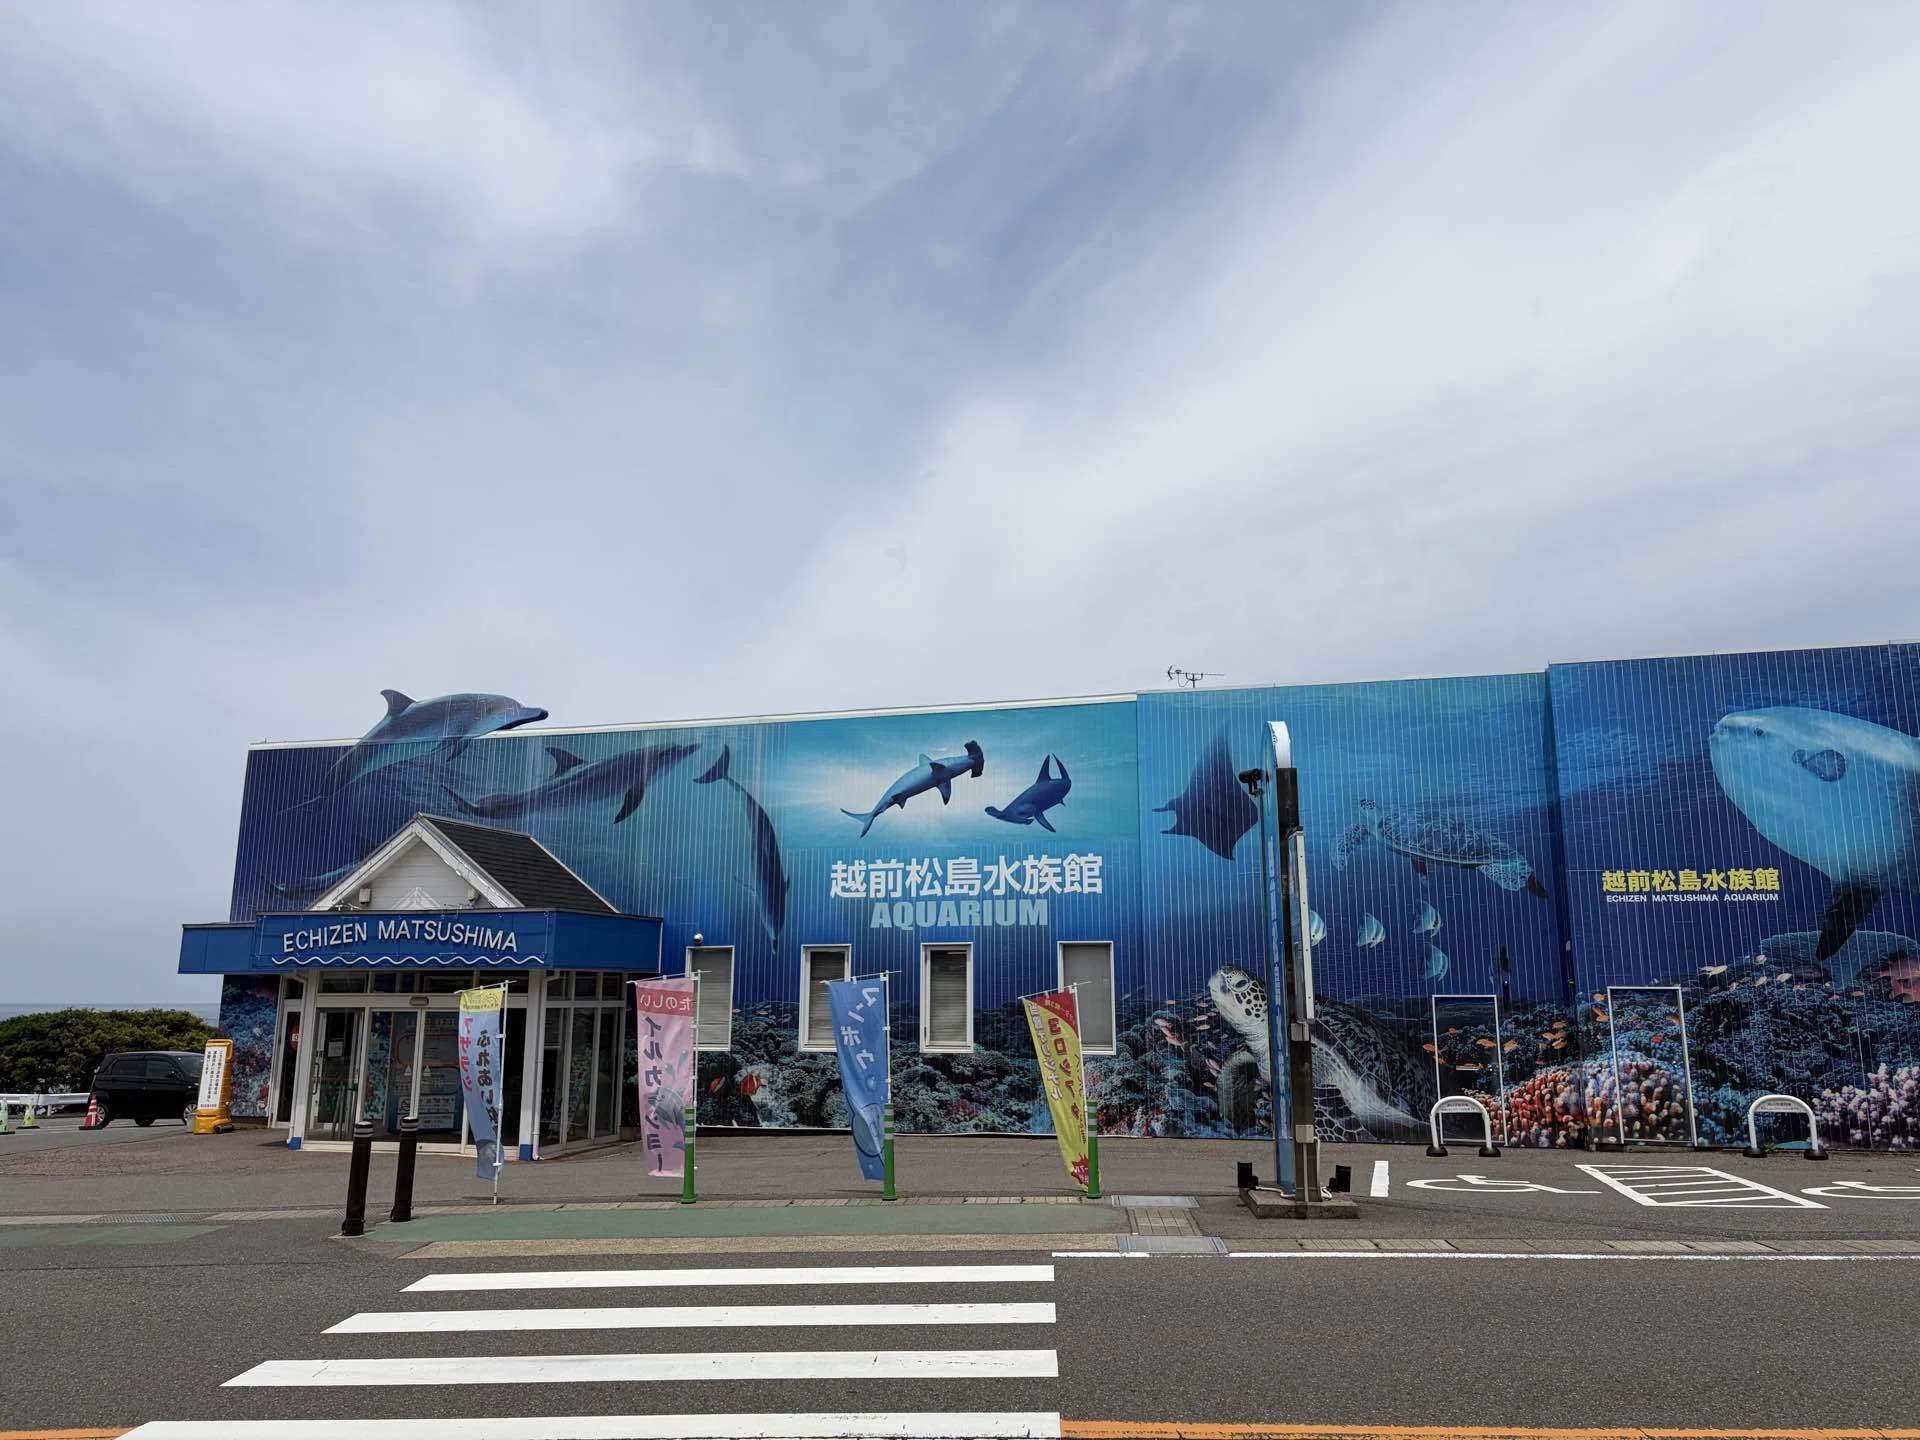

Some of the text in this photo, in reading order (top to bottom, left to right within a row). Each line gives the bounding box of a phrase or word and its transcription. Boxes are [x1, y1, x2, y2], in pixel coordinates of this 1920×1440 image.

[830, 853, 1102, 898] 越前松島水族館
[1602, 868, 1780, 892] 越前松島水族館
[1606, 893, 1779, 903] ECHIZEN MATSUSHIMA AQUARIUM
[869, 899, 1049, 931] AQUARIUM
[283, 920, 518, 952] ECHIZEN MATSUSHIMA
